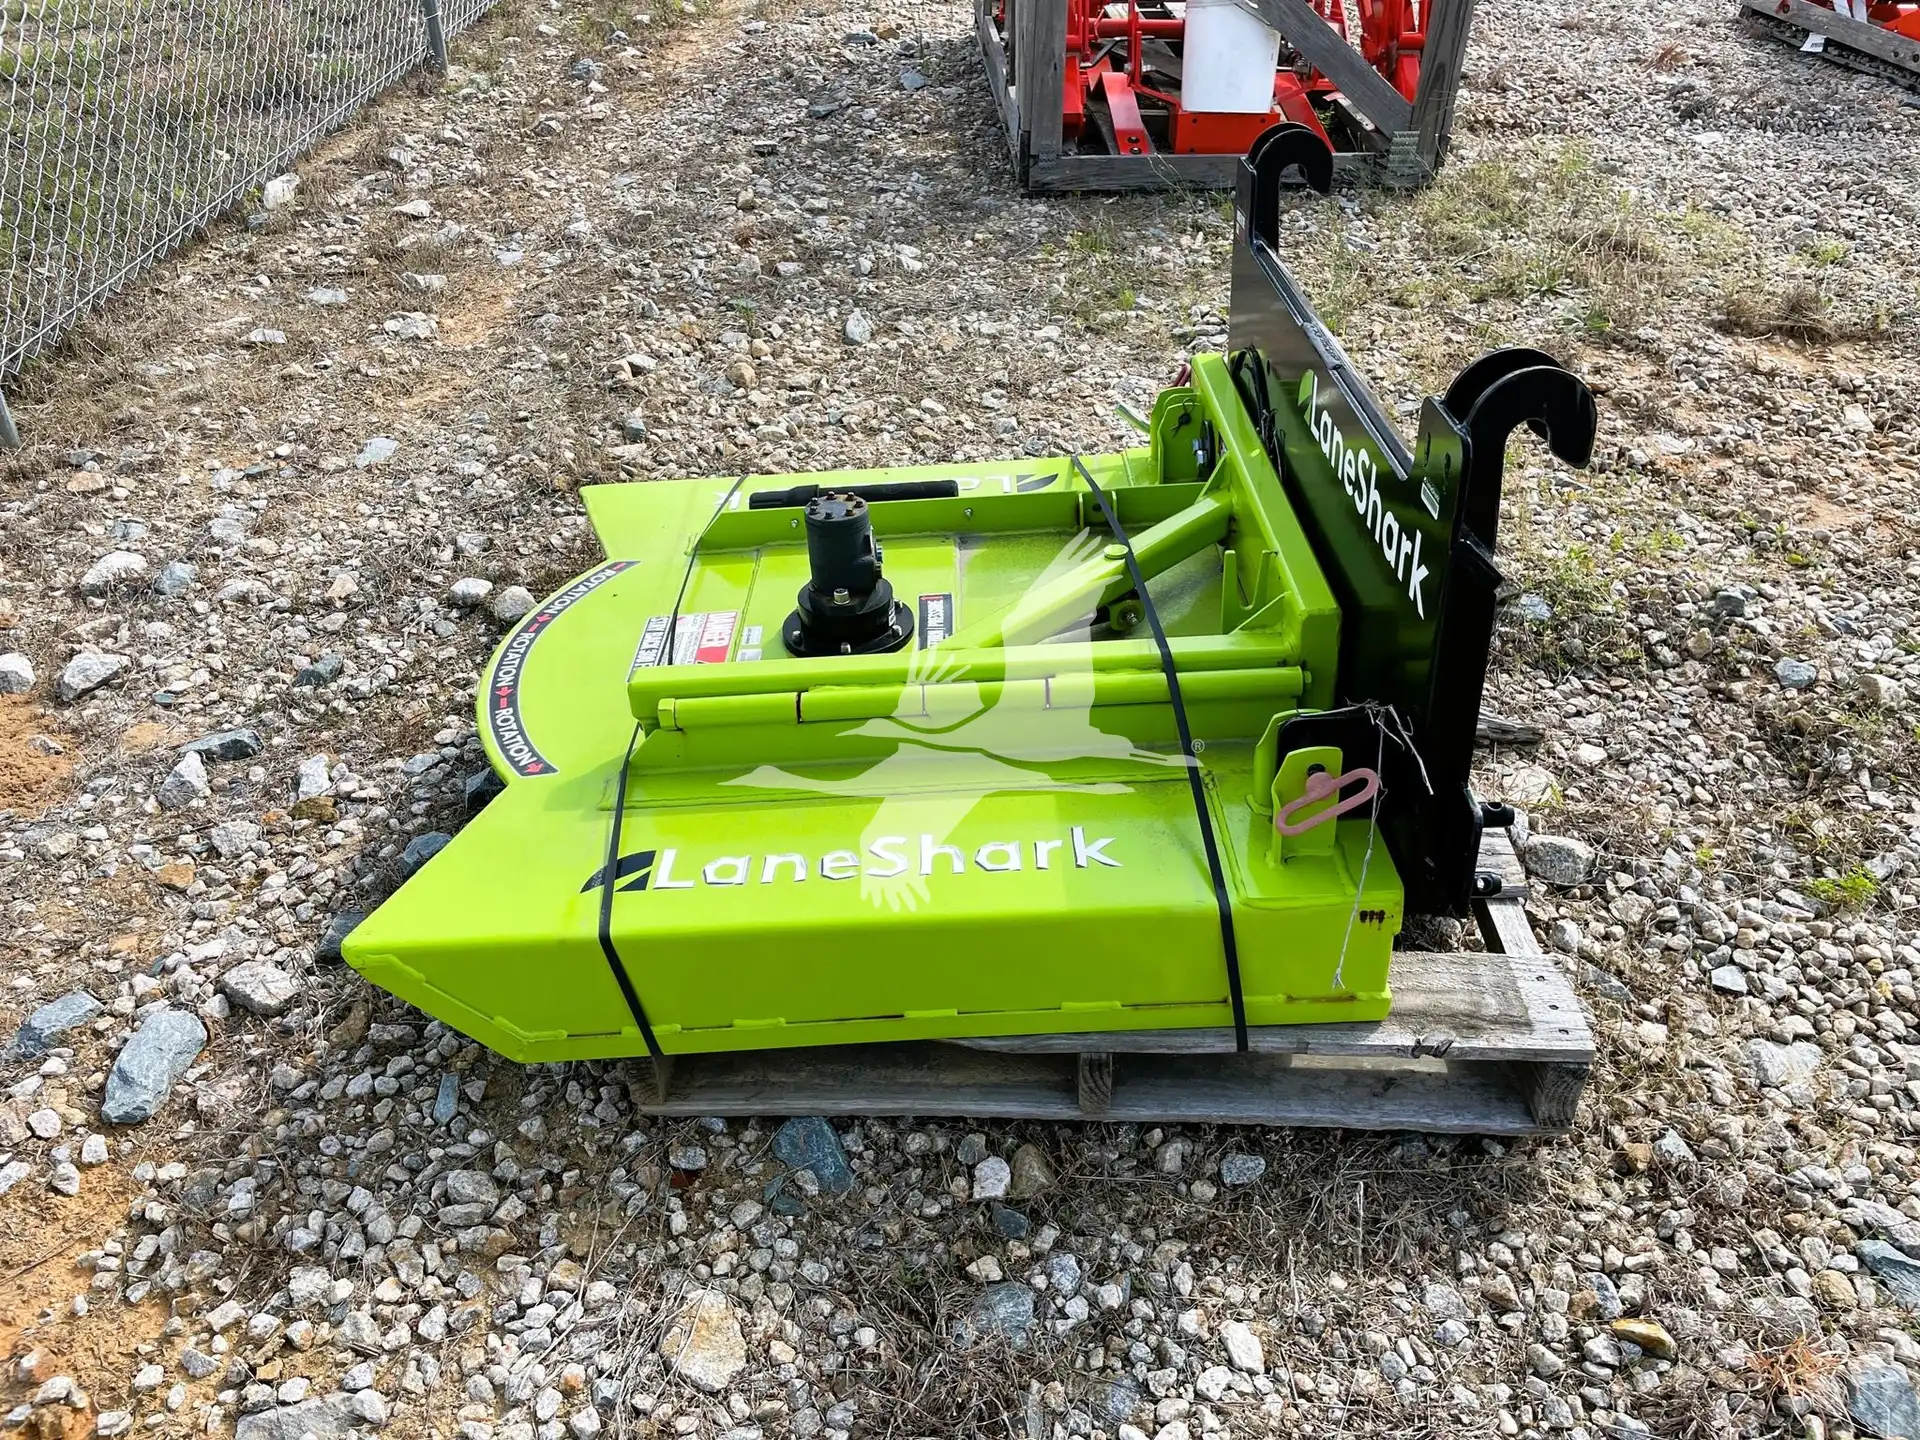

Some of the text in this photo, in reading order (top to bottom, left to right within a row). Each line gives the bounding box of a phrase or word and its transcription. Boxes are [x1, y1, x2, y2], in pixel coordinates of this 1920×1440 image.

[1310, 374, 1430, 620] LaneShark
[543, 568, 616, 614] ROTATION
[700, 611, 738, 648] DANGER
[495, 632, 536, 687] ROTATION
[495, 707, 537, 766] ROTATION
[653, 826, 1123, 890] LaneShark
